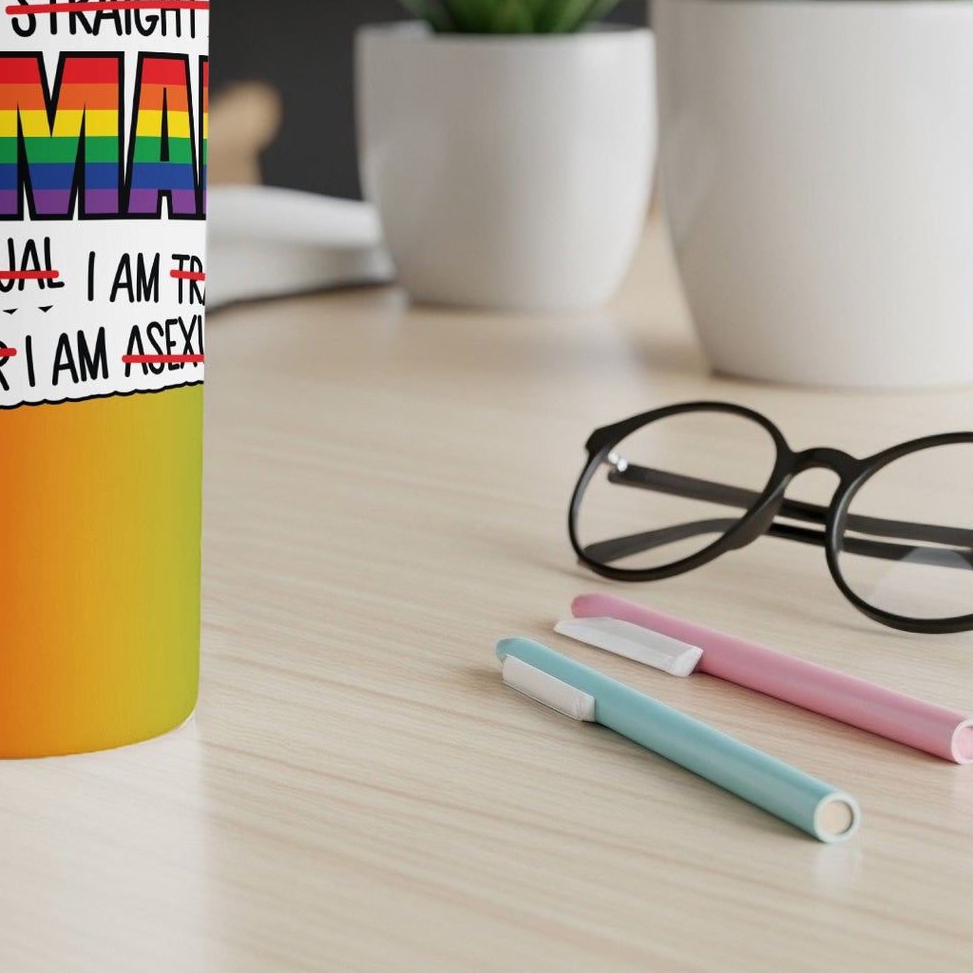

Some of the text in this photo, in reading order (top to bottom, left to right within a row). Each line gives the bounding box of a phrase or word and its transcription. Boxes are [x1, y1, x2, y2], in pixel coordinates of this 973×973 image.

[87, 251, 96, 302] I
[109, 252, 160, 304] AM
[171, 253, 206, 306] TR
[25, 334, 36, 388] I
[51, 326, 109, 387] AM
